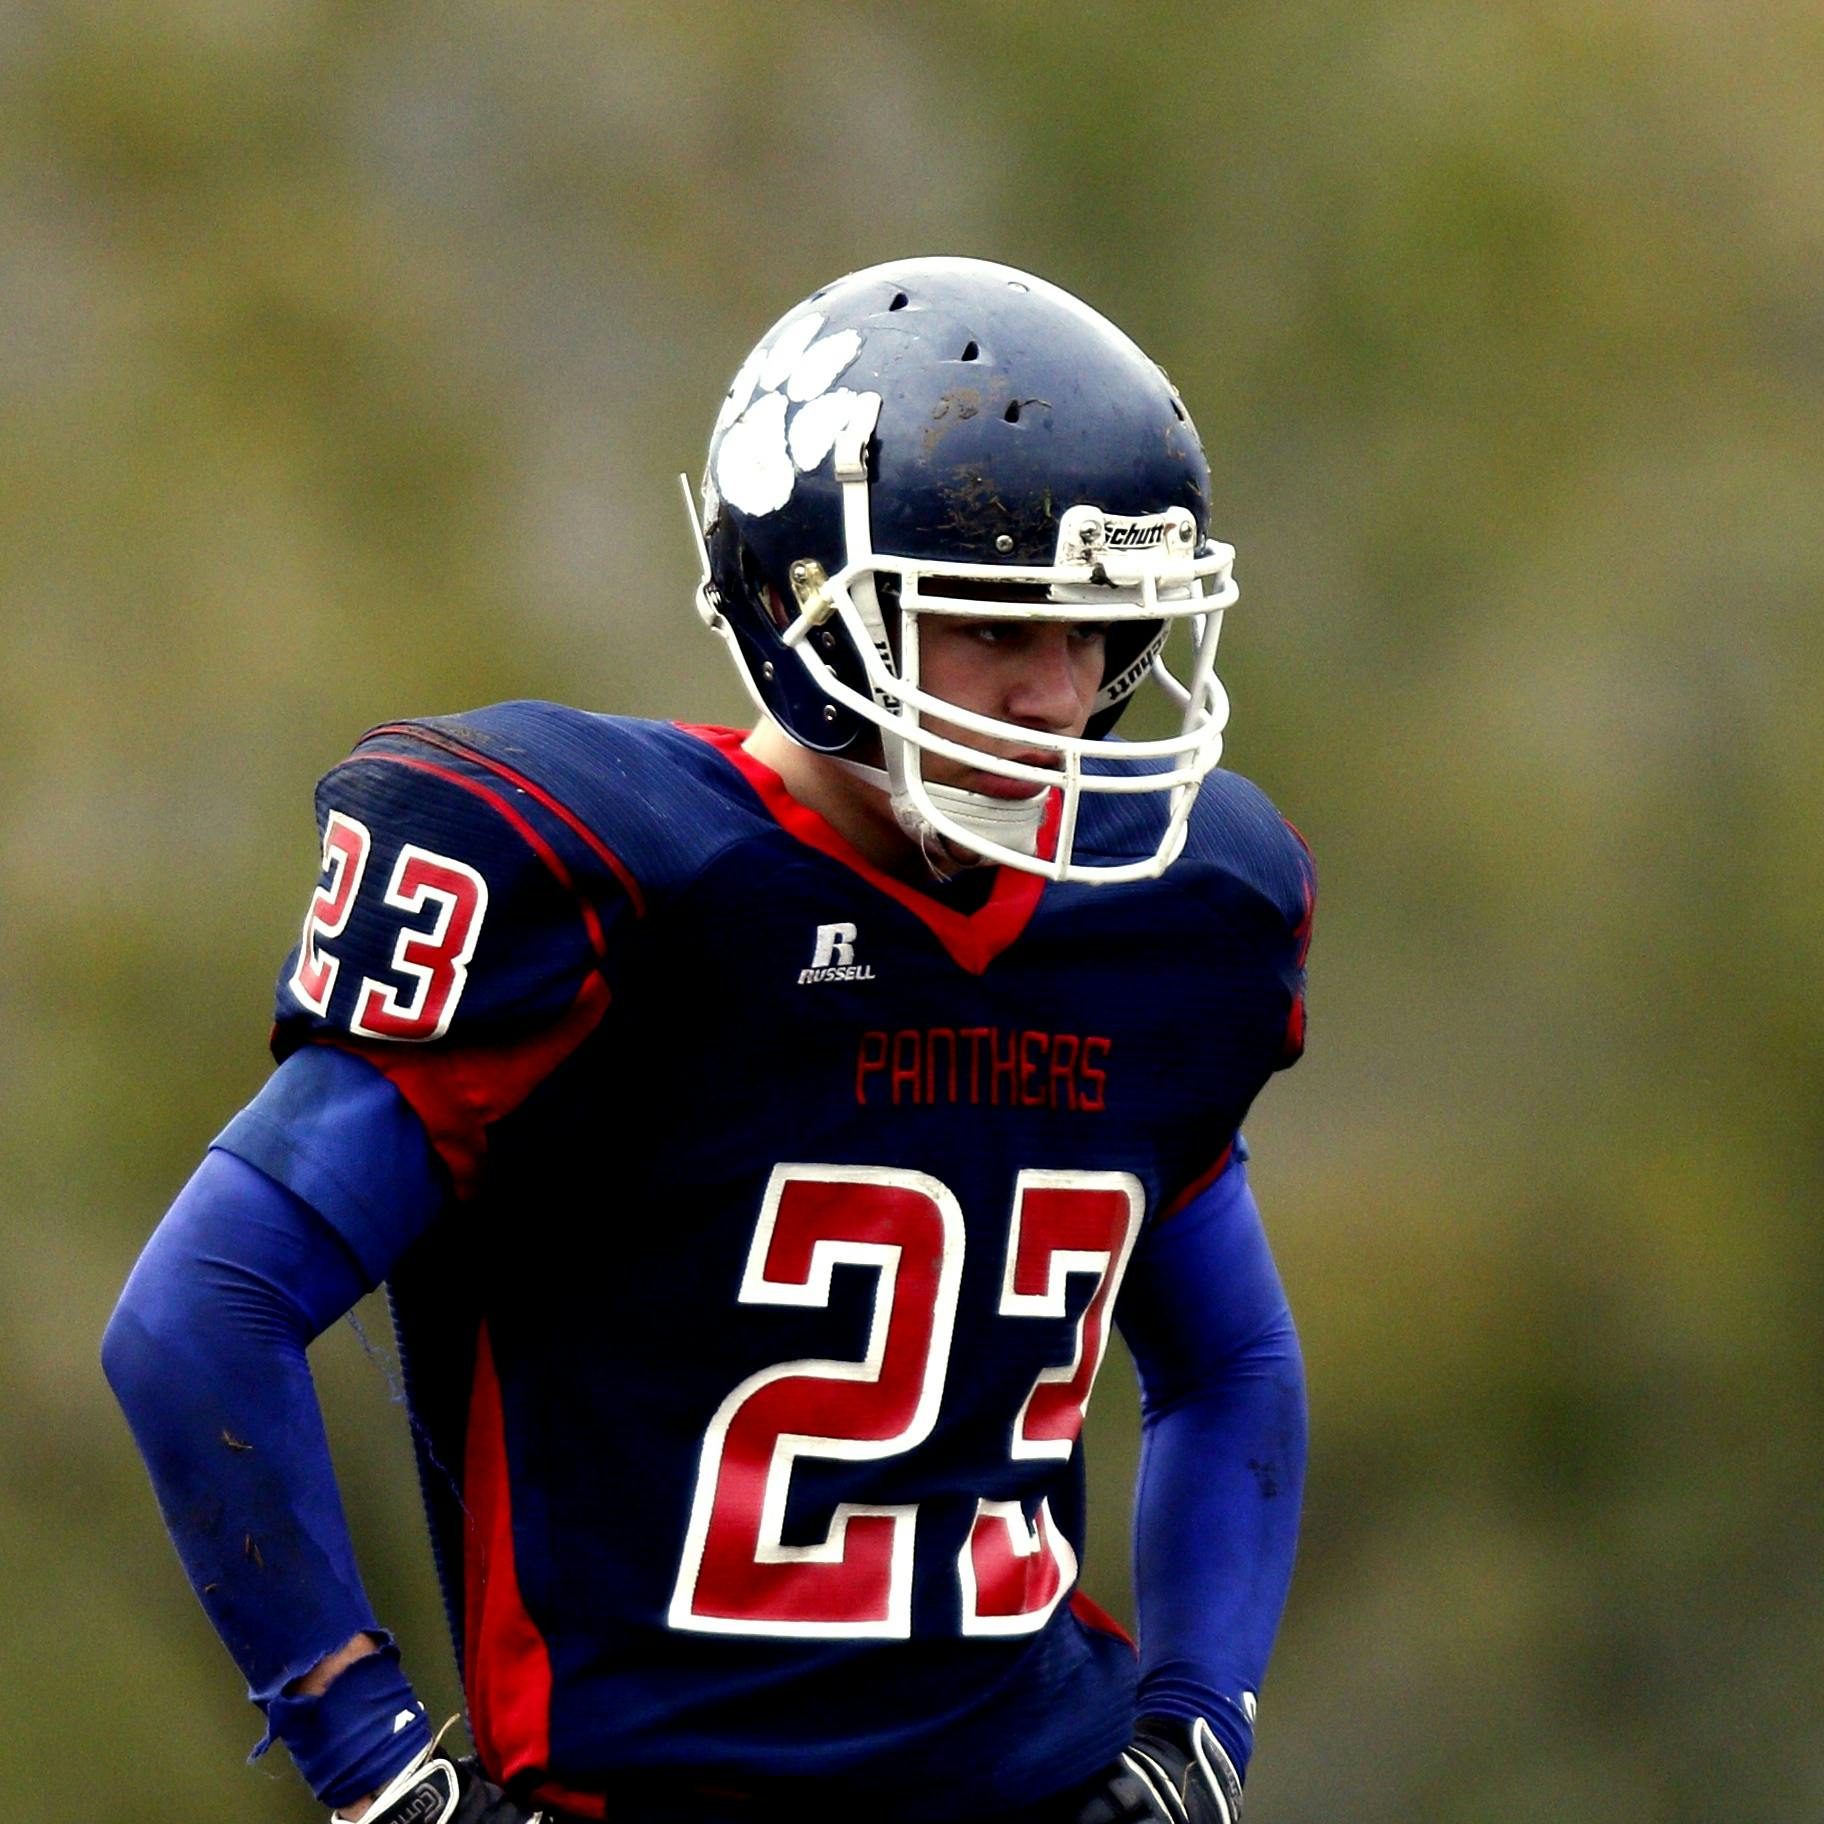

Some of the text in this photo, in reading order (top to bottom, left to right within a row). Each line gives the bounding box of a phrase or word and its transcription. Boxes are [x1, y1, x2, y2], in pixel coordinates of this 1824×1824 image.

[288, 809, 488, 1042] 23
[811, 922, 858, 968] R
[797, 964, 876, 985] RUSSELL
[855, 1027, 1113, 1112] PANTHERS
[668, 1162, 1146, 1639] 23
